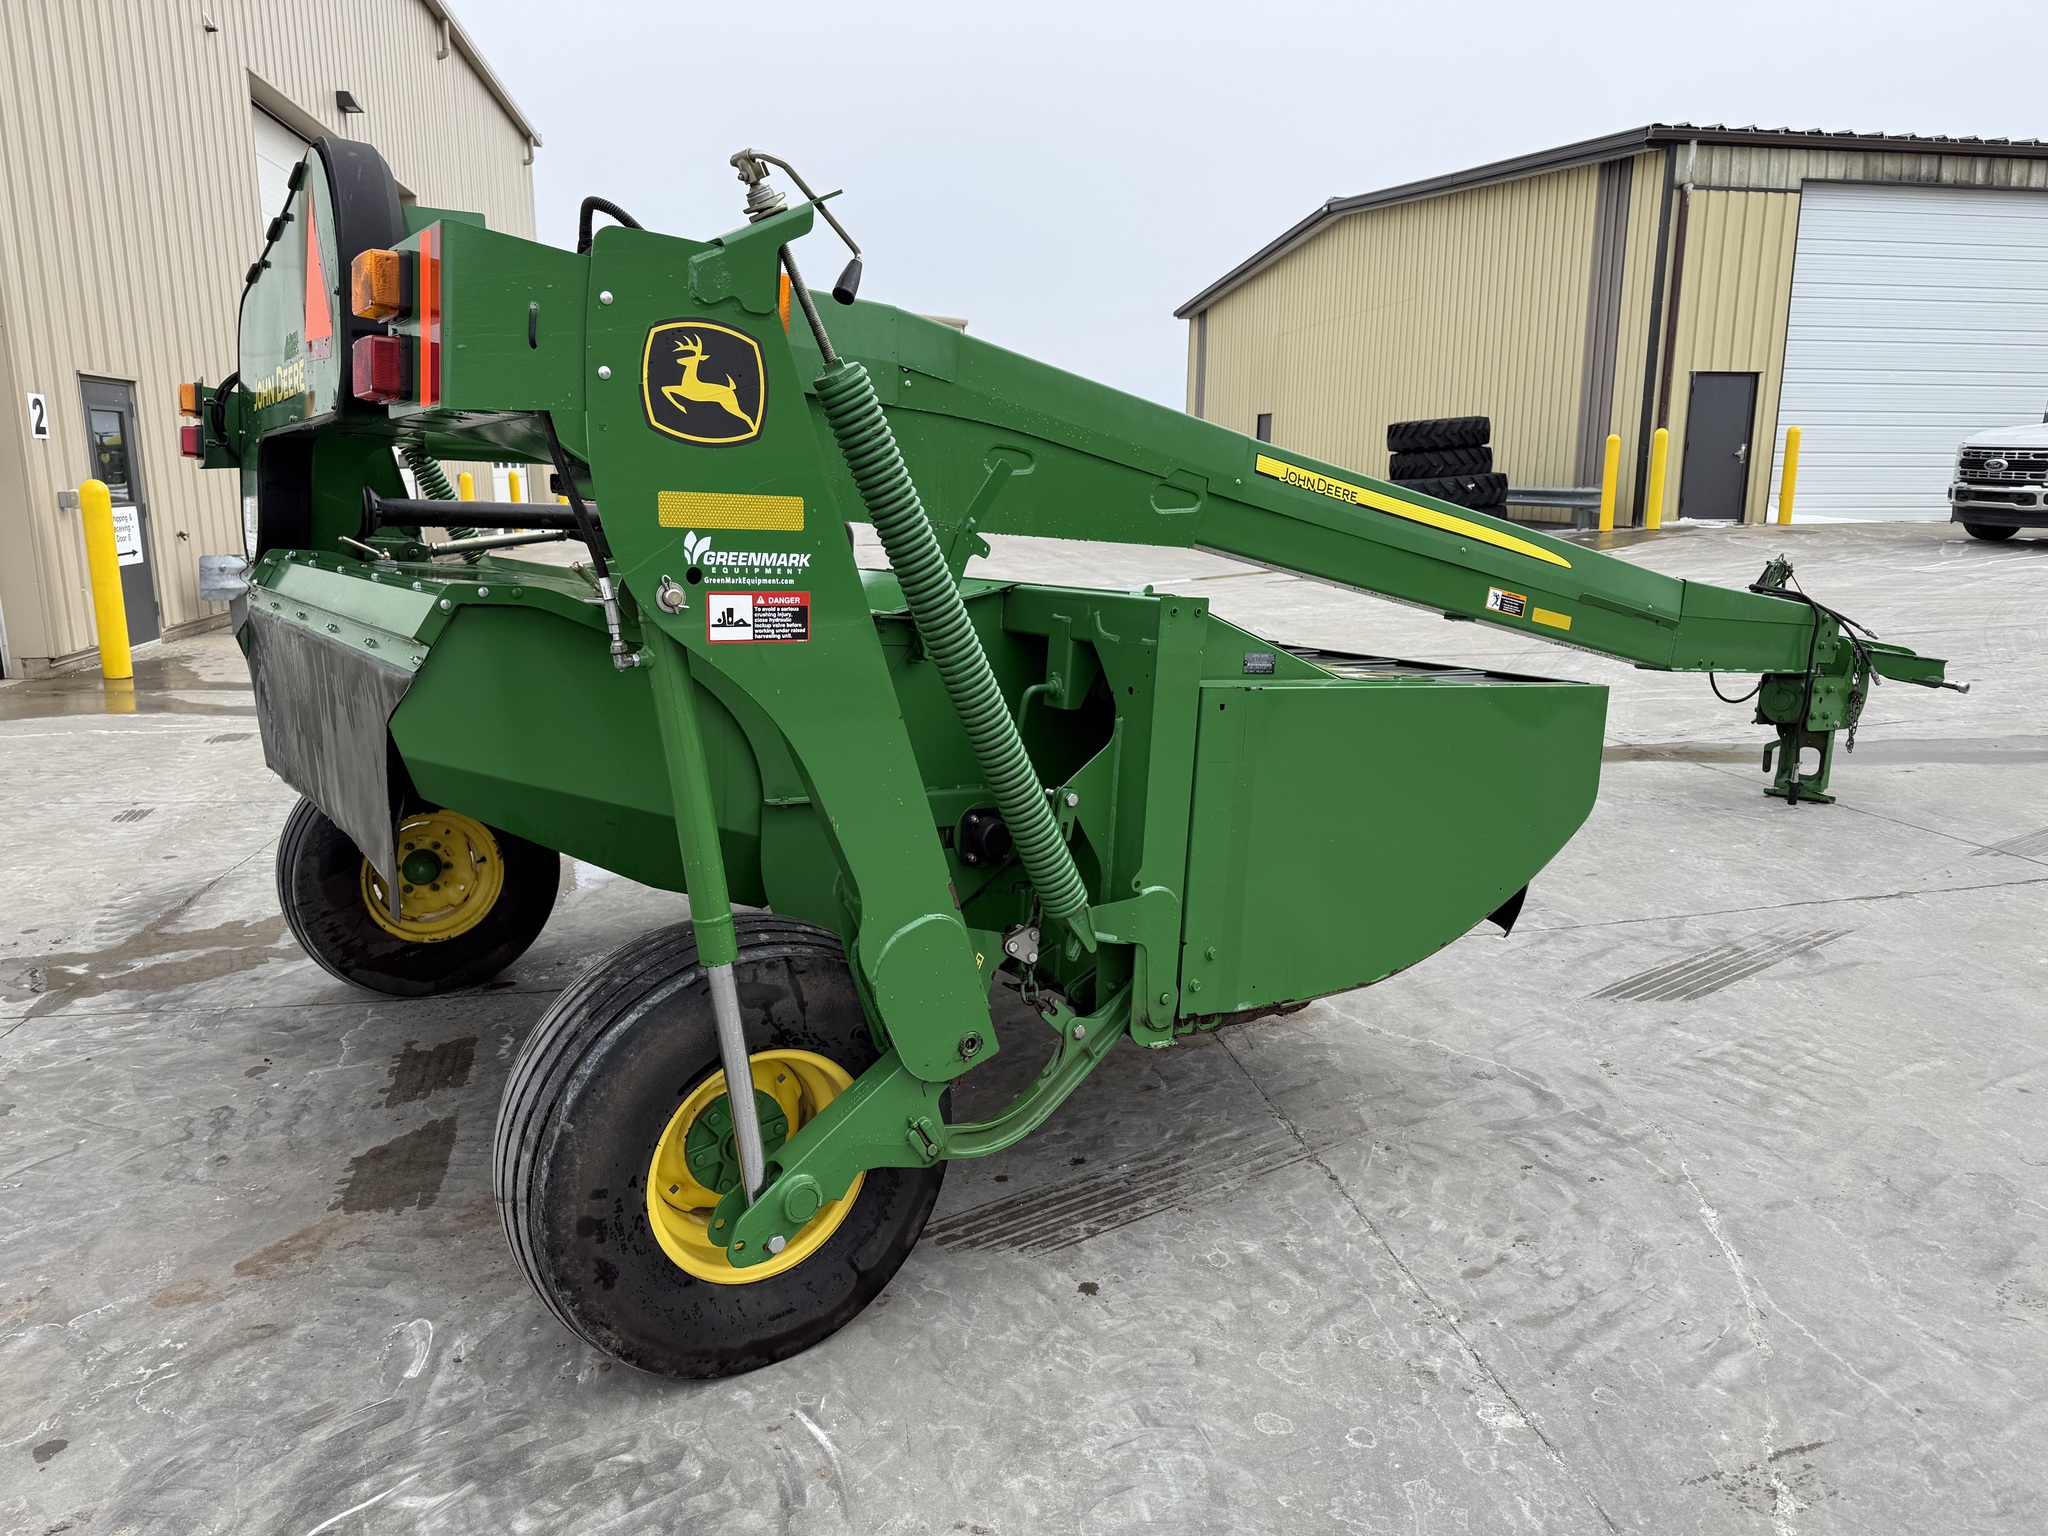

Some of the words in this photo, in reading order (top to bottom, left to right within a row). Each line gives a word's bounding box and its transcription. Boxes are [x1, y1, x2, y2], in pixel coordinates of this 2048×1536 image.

[254, 375, 275, 412] JOHN
[276, 359, 305, 402] DEERE
[32, 398, 46, 434] 2
[1281, 468, 1316, 490] JOHN
[1317, 478, 1358, 502] DEERE
[113, 514, 128, 522] hipping
[114, 524, 131, 533] eceiving
[703, 551, 811, 567] GREENMARK
[711, 567, 802, 575] EQUIPMENT
[704, 576, 795, 585] GreenMarkEquipment.com
